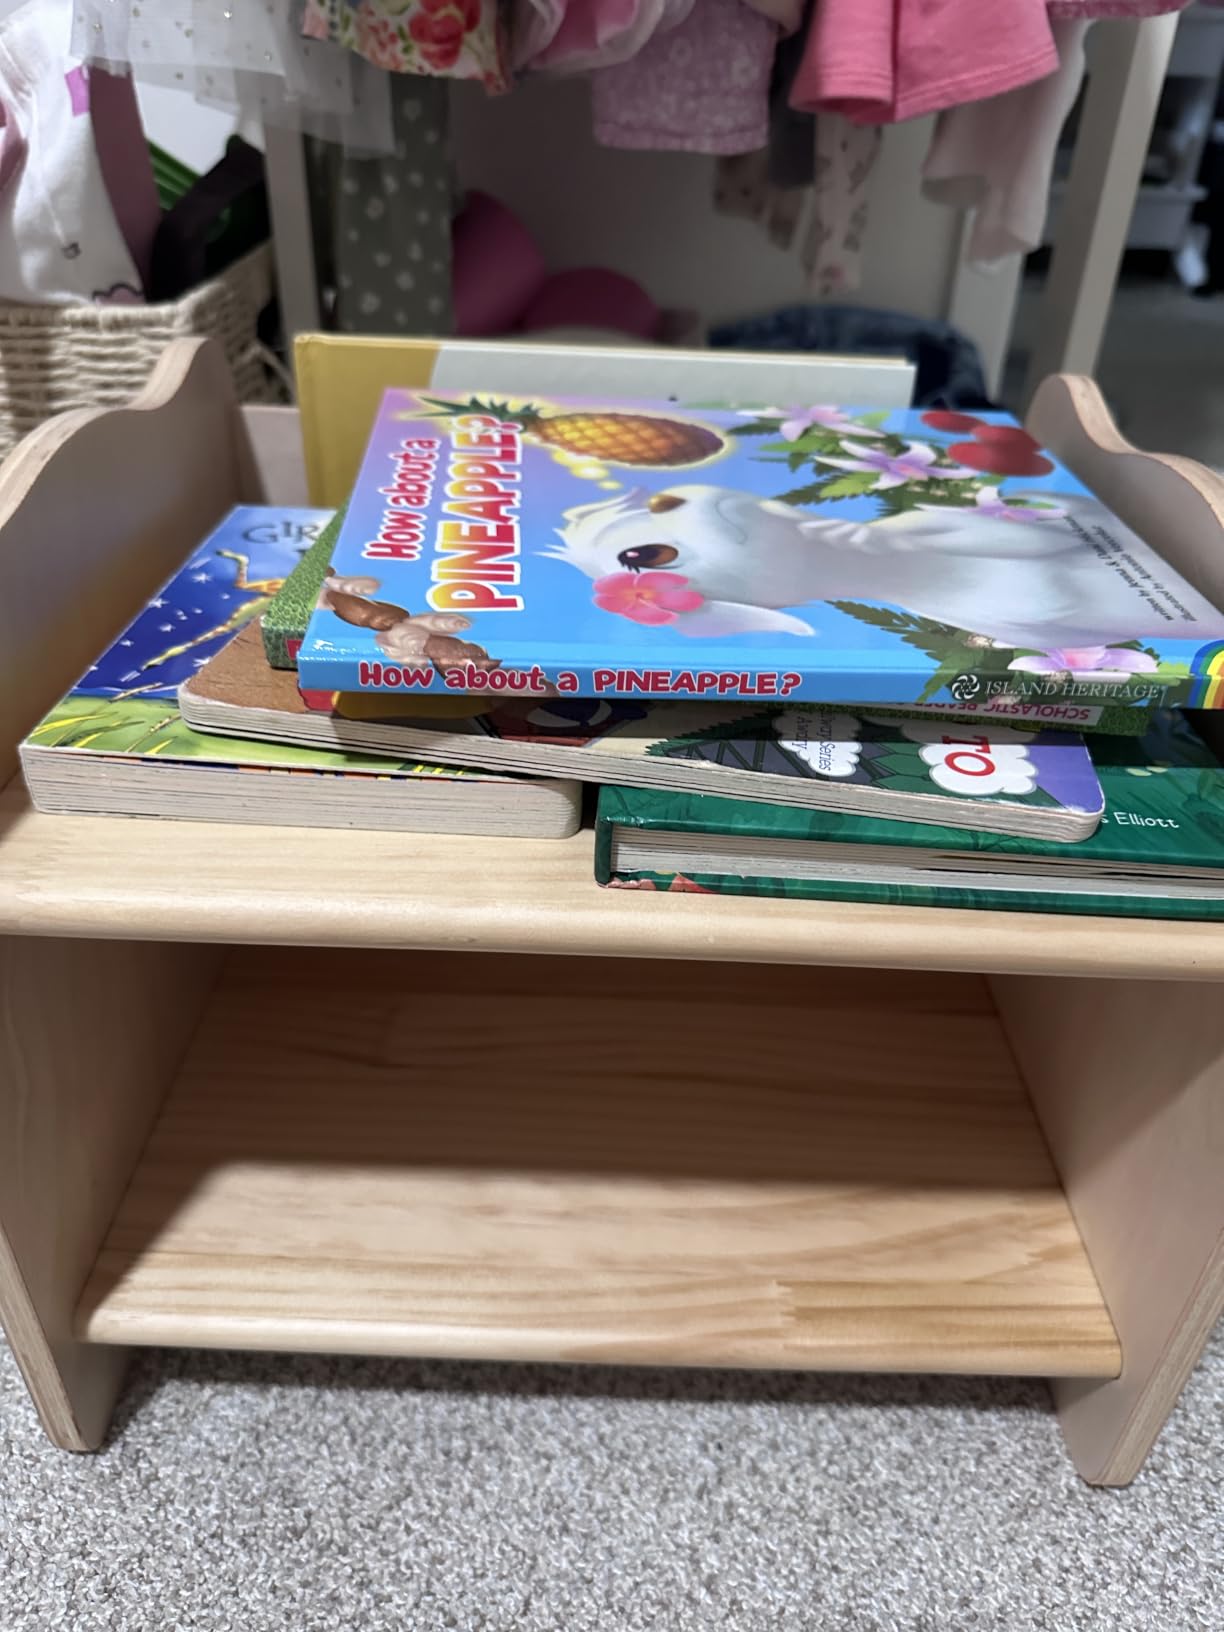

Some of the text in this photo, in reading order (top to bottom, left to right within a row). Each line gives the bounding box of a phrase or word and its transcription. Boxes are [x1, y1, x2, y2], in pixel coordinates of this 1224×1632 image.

[361, 436, 441, 561] How about a
[426, 413, 525, 612] PINEAPPLE?
[241, 520, 320, 544] GIR
[359, 659, 803, 696] How about a PINEAPPLE?
[984, 680, 1160, 699] ISLAND HERITAGE
[983, 703, 1091, 721] SCHOLASTIC
[818, 741, 836, 772] Series
[941, 735, 996, 777] TO
[1113, 811, 1180, 829] Elliott
